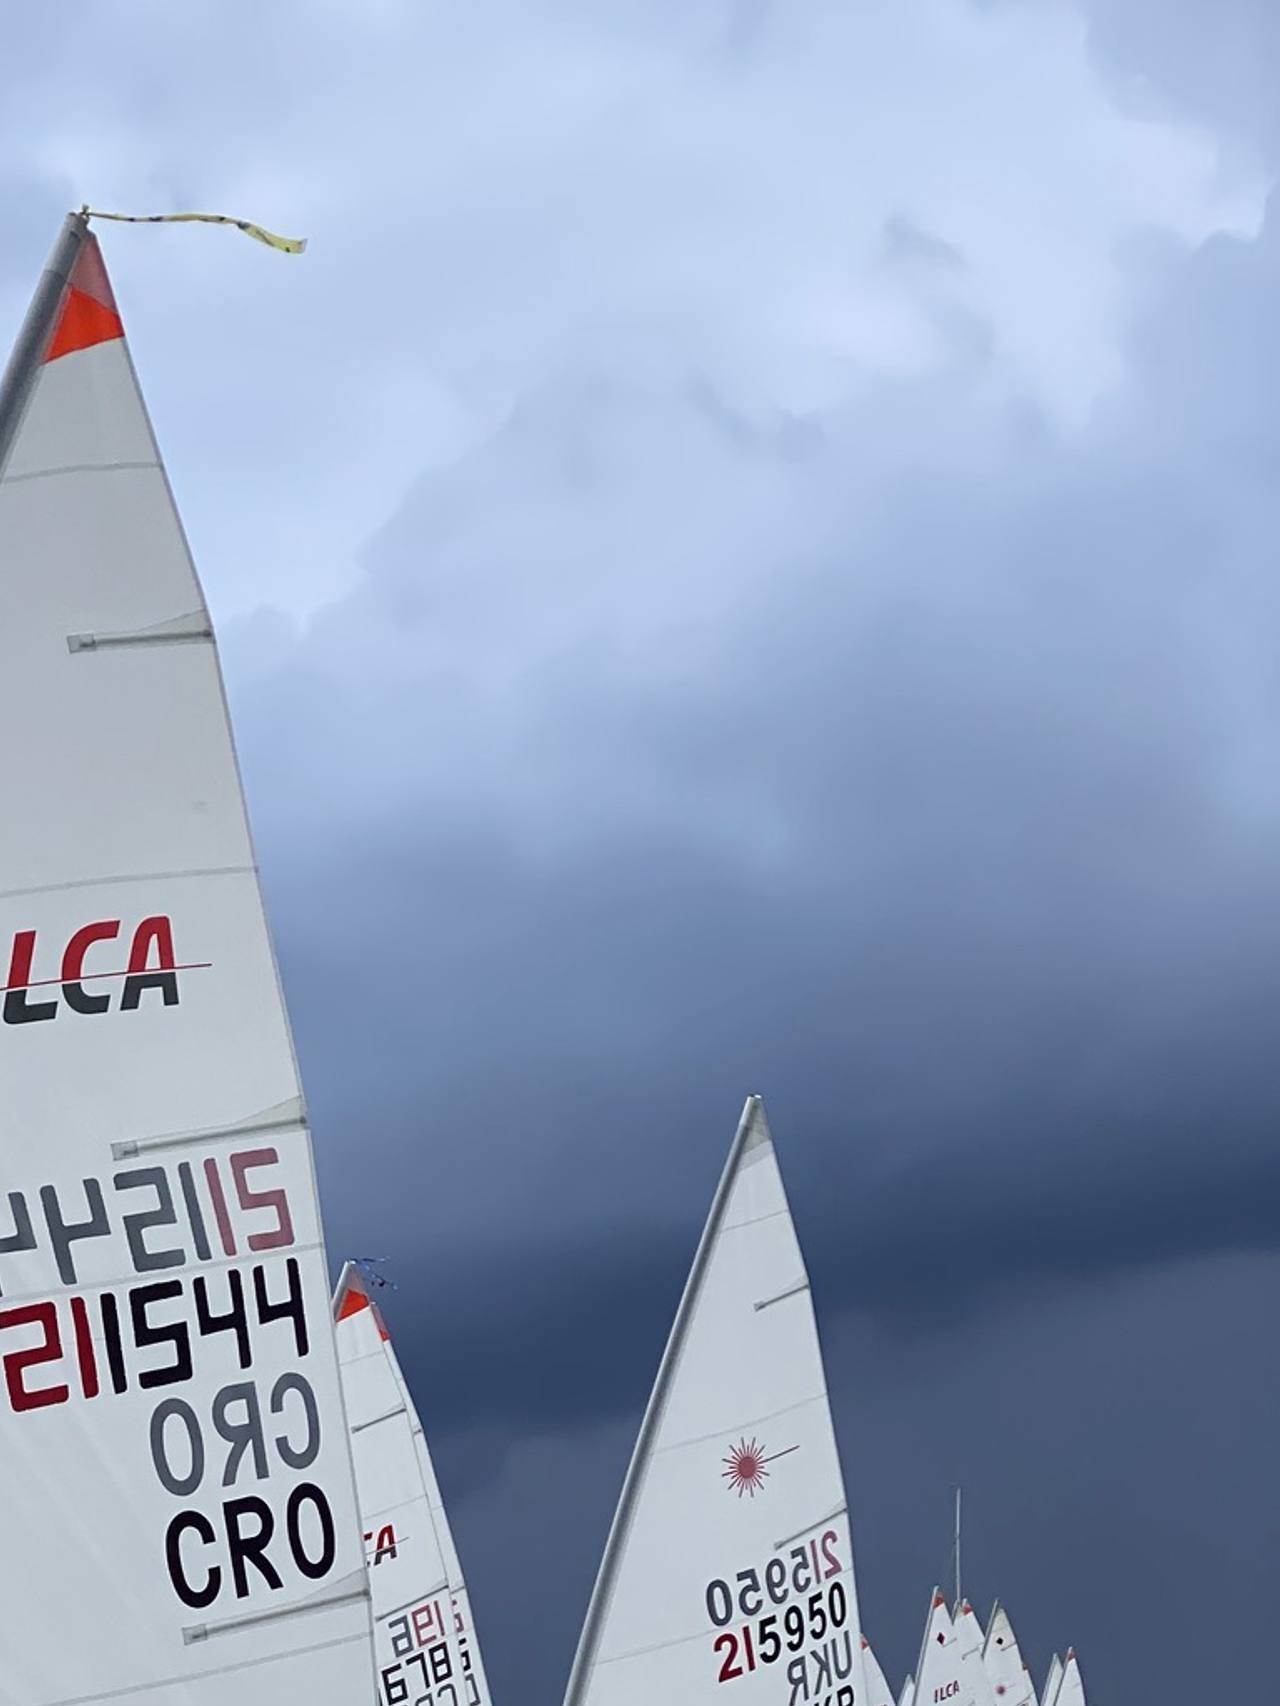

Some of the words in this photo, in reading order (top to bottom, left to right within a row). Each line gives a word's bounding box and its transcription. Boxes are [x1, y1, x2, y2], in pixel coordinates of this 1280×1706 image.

[166, 1482, 336, 1609] CRO
[713, 1581, 847, 1683] 215950
[934, 1680, 960, 1704] ILCA
